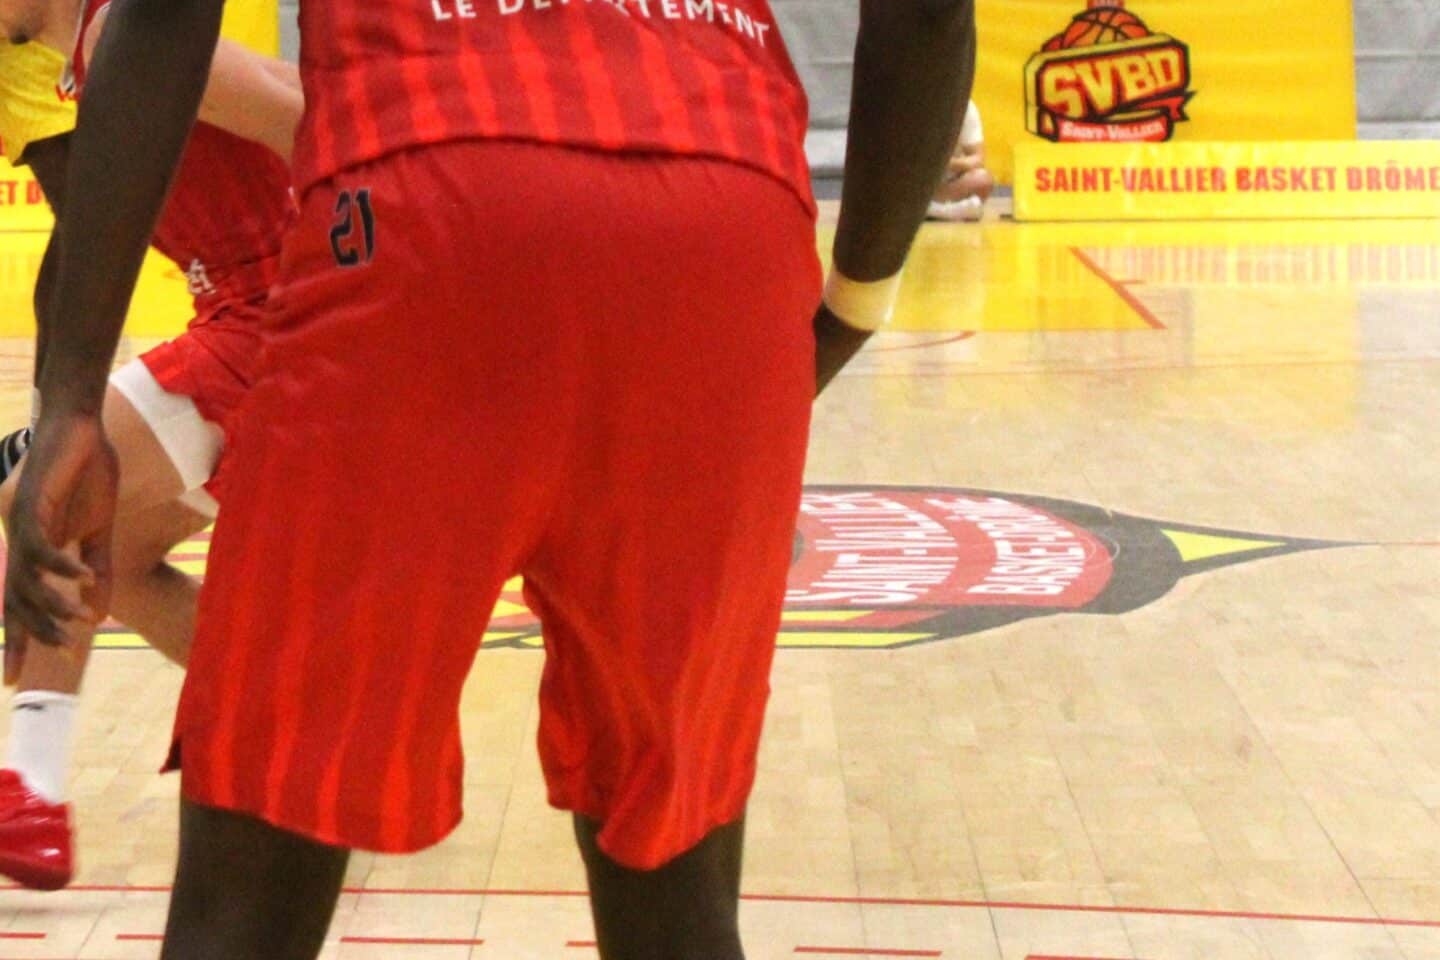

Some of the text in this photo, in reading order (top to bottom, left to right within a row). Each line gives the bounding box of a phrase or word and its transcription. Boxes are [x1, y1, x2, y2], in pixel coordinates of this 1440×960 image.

[1042, 48, 1181, 119] SVBD
[1035, 160, 1440, 193] SAINT-VALLIER BASKET DRÔME
[330, 186, 375, 267] 21
